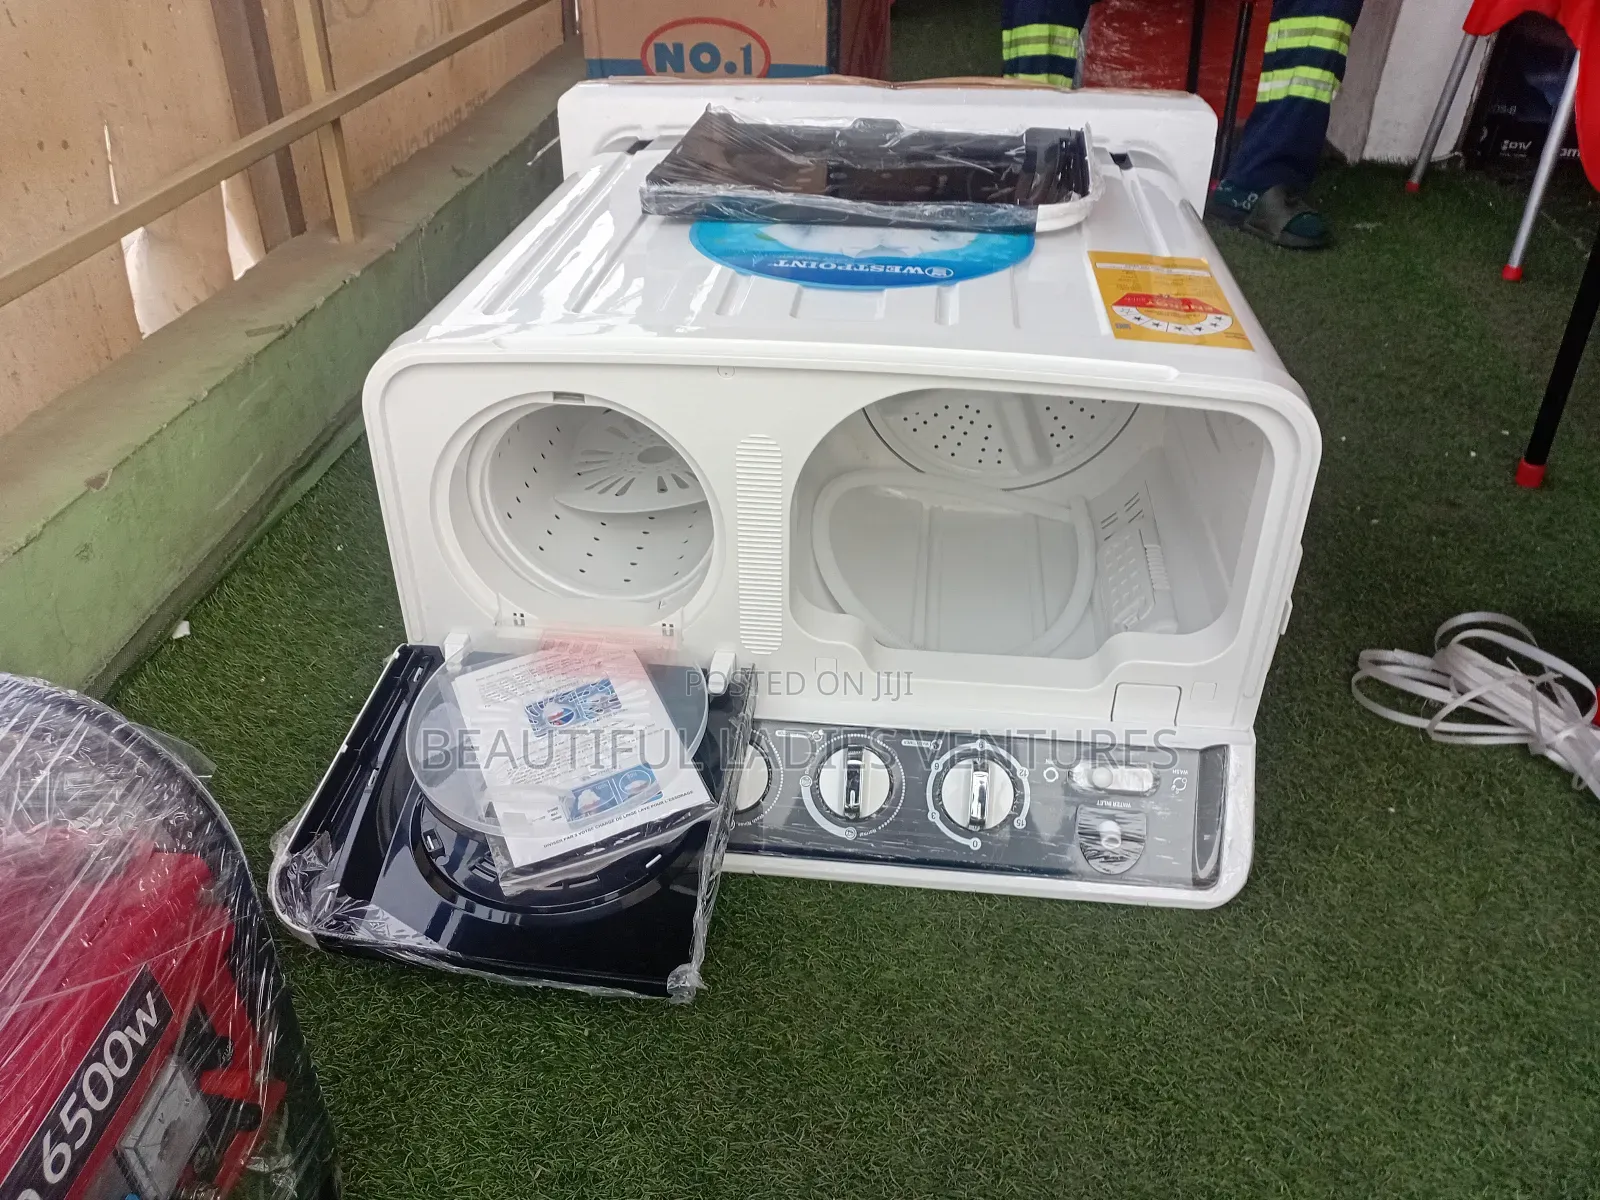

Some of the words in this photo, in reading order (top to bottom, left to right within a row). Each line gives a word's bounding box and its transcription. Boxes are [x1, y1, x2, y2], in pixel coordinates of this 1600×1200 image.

[654, 41, 752, 75] NO.1
[773, 258, 925, 275] WESTPOINT
[1019, 768, 1028, 776] 12
[1096, 799, 1112, 807] INLET
[595, 819, 615, 829] CHARGE
[1017, 819, 1024, 827] 15
[42, 990, 159, 1185] 6500w
